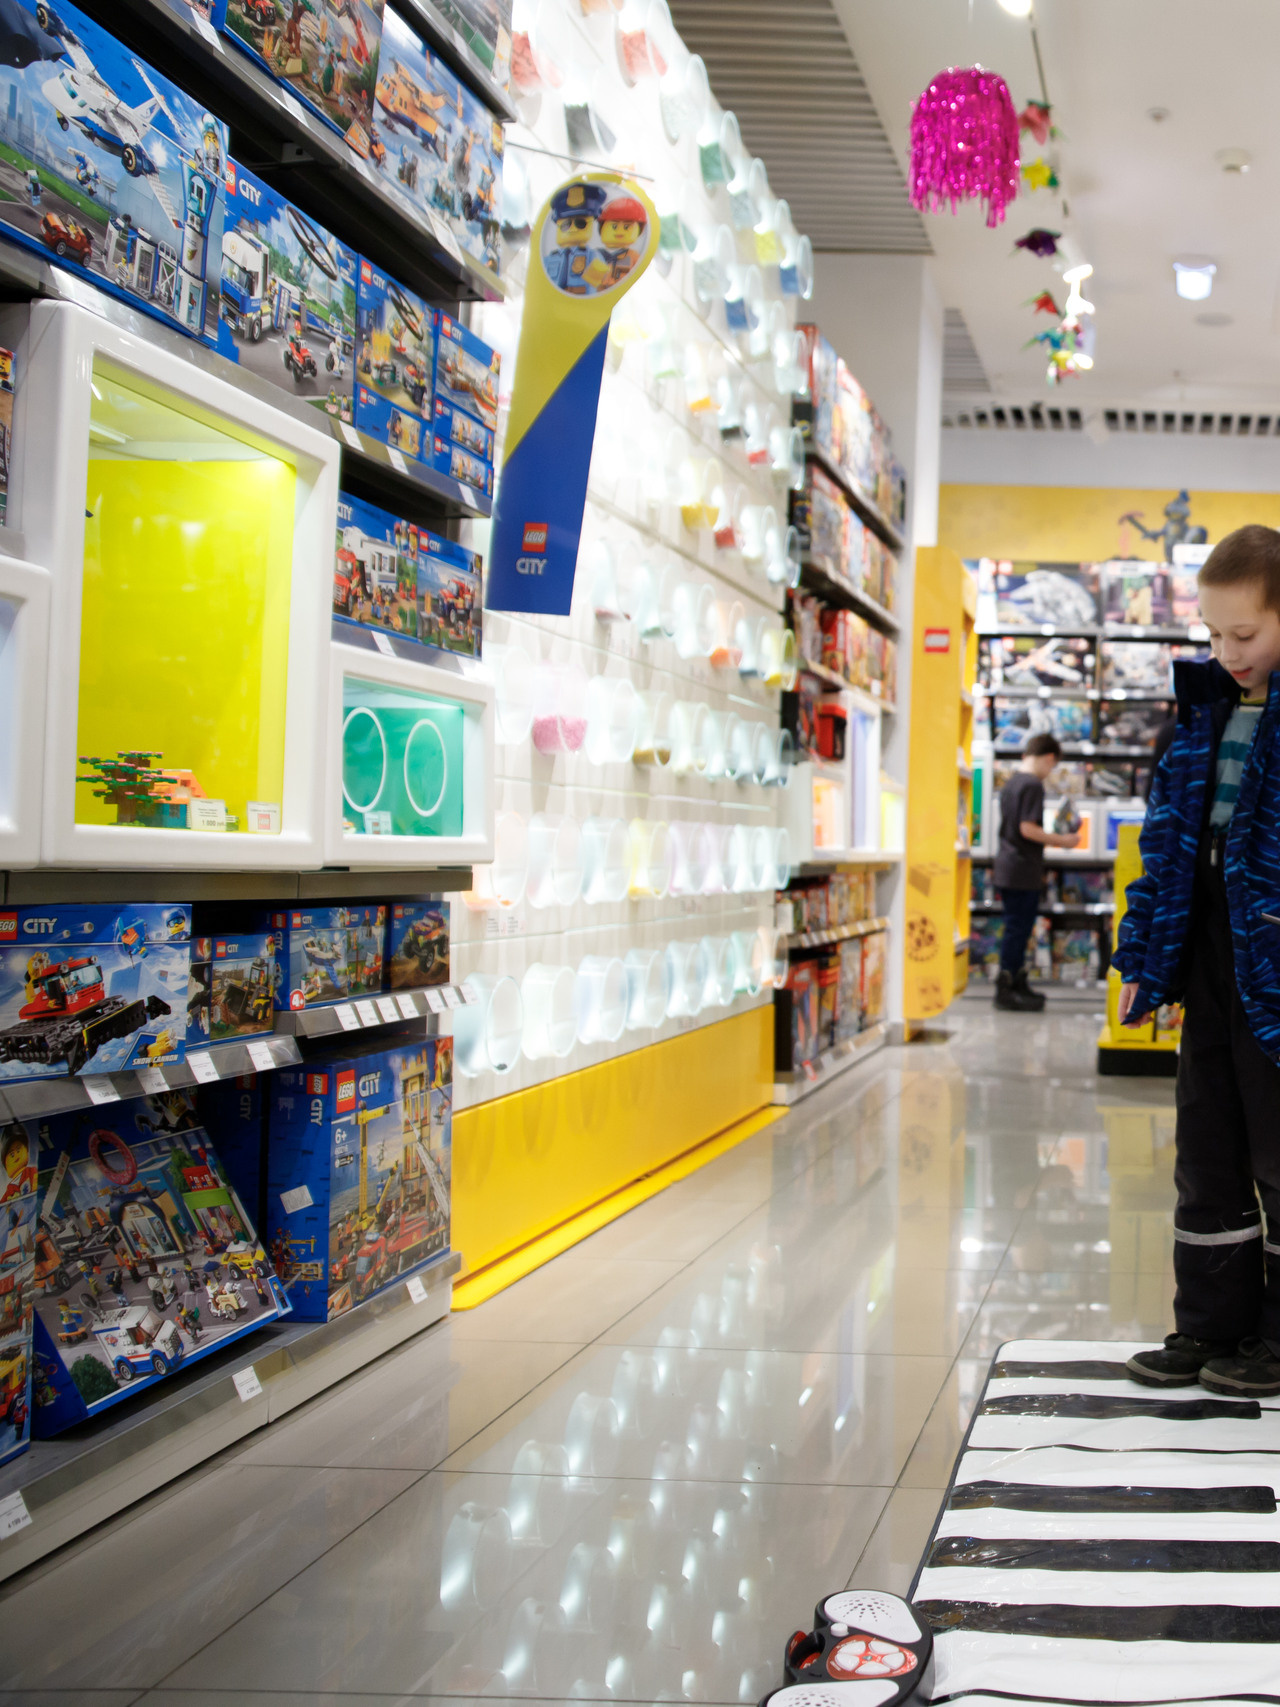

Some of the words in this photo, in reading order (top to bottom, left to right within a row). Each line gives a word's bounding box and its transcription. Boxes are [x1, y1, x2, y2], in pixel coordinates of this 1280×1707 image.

[238, 178, 262, 207] CITY
[372, 274, 386, 291] CITY
[337, 503, 353, 522] CITY
[429, 540, 441, 553] CITY
[524, 531, 547, 545] LEGO
[515, 557, 547, 575] CITY
[0, 918, 17, 932] EGO
[23, 918, 58, 934] CITY
[302, 915, 313, 924] CITY
[227, 944, 239, 953] CITY
[291, 993, 304, 1008] 4+
[153, 1054, 179, 1063] CANNON
[314, 1074, 323, 1094] LEGO
[338, 1081, 355, 1101] LEGO
[359, 1071, 381, 1098] CITY
[240, 1094, 252, 1121] CITY
[311, 1098, 323, 1127] CITY
[335, 1128, 347, 1144] 6+
